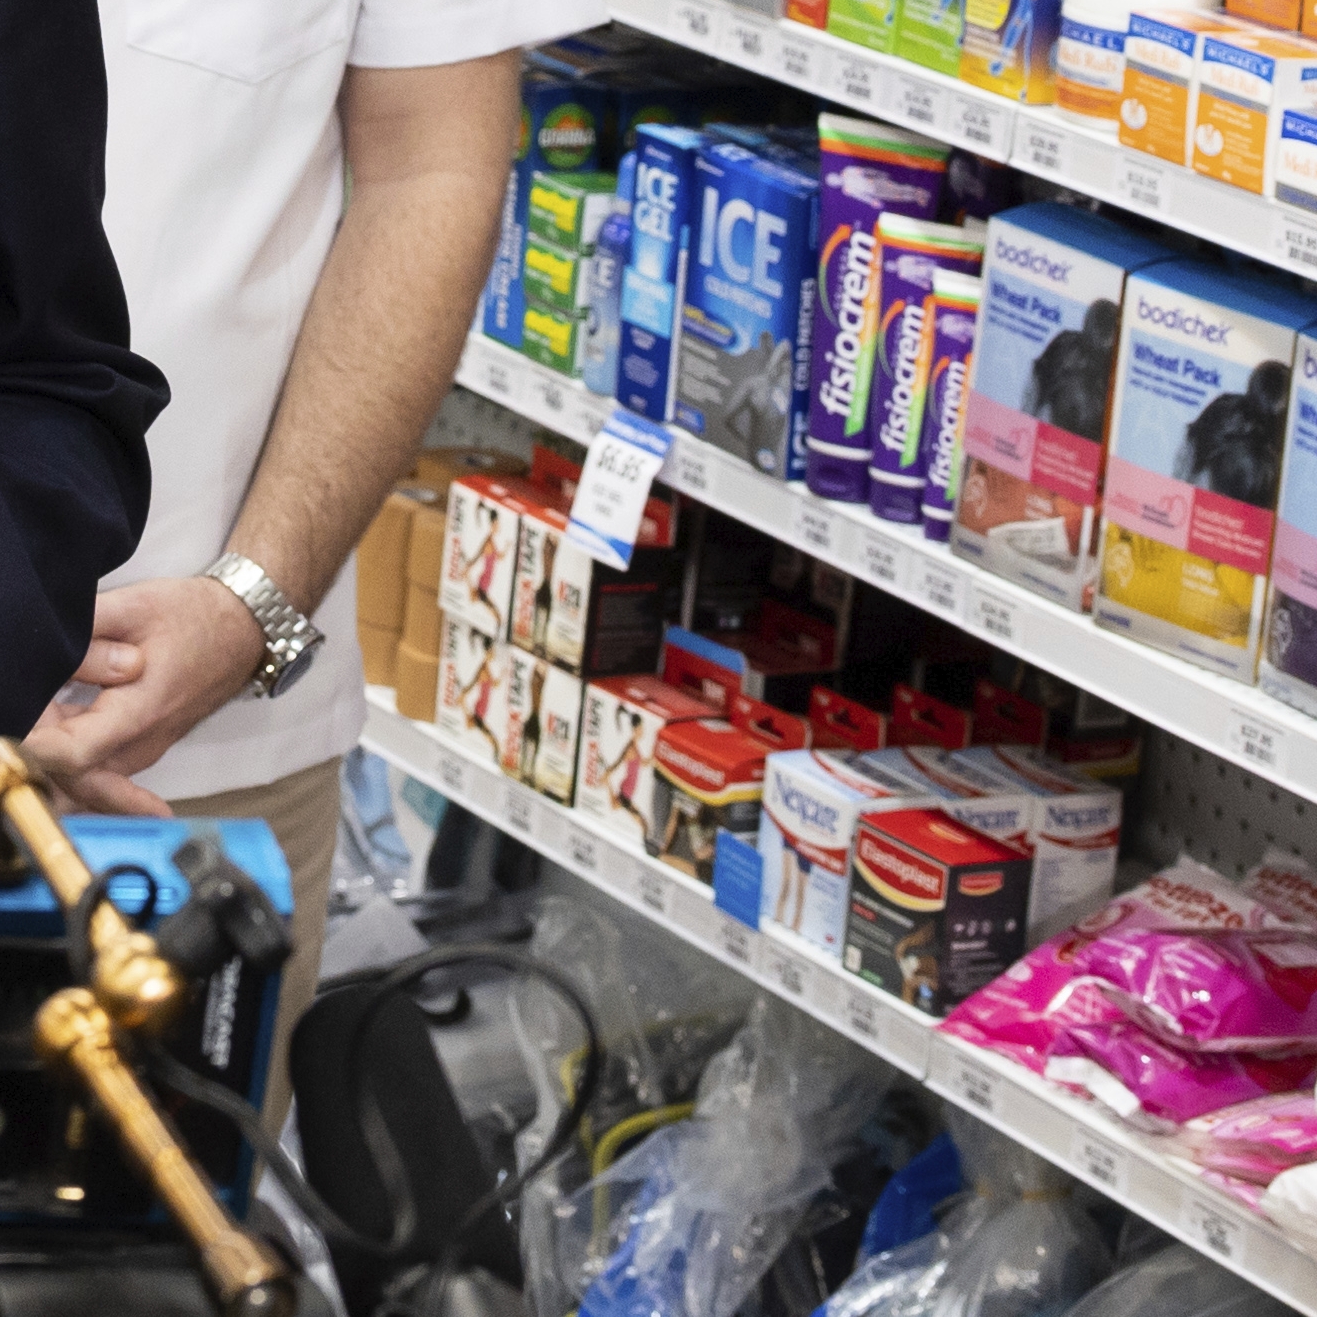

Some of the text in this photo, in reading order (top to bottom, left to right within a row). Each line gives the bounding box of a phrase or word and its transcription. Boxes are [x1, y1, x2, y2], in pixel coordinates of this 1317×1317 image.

[635, 163, 680, 211] ICE
[633, 201, 677, 243] GEL
[698, 186, 787, 299] ICE
[994, 236, 1072, 285] bodichek
[820, 230, 877, 420] fisiocrem
[1027, 294, 1063, 325] Pack
[1136, 294, 1234, 347] bodichek
[879, 303, 926, 454] fisiocrem
[1132, 340, 1182, 375] Wheat
[1183, 357, 1222, 389] Pack
[928, 359, 967, 491] fisiocrem
[859, 837, 941, 894] Elastoplast
